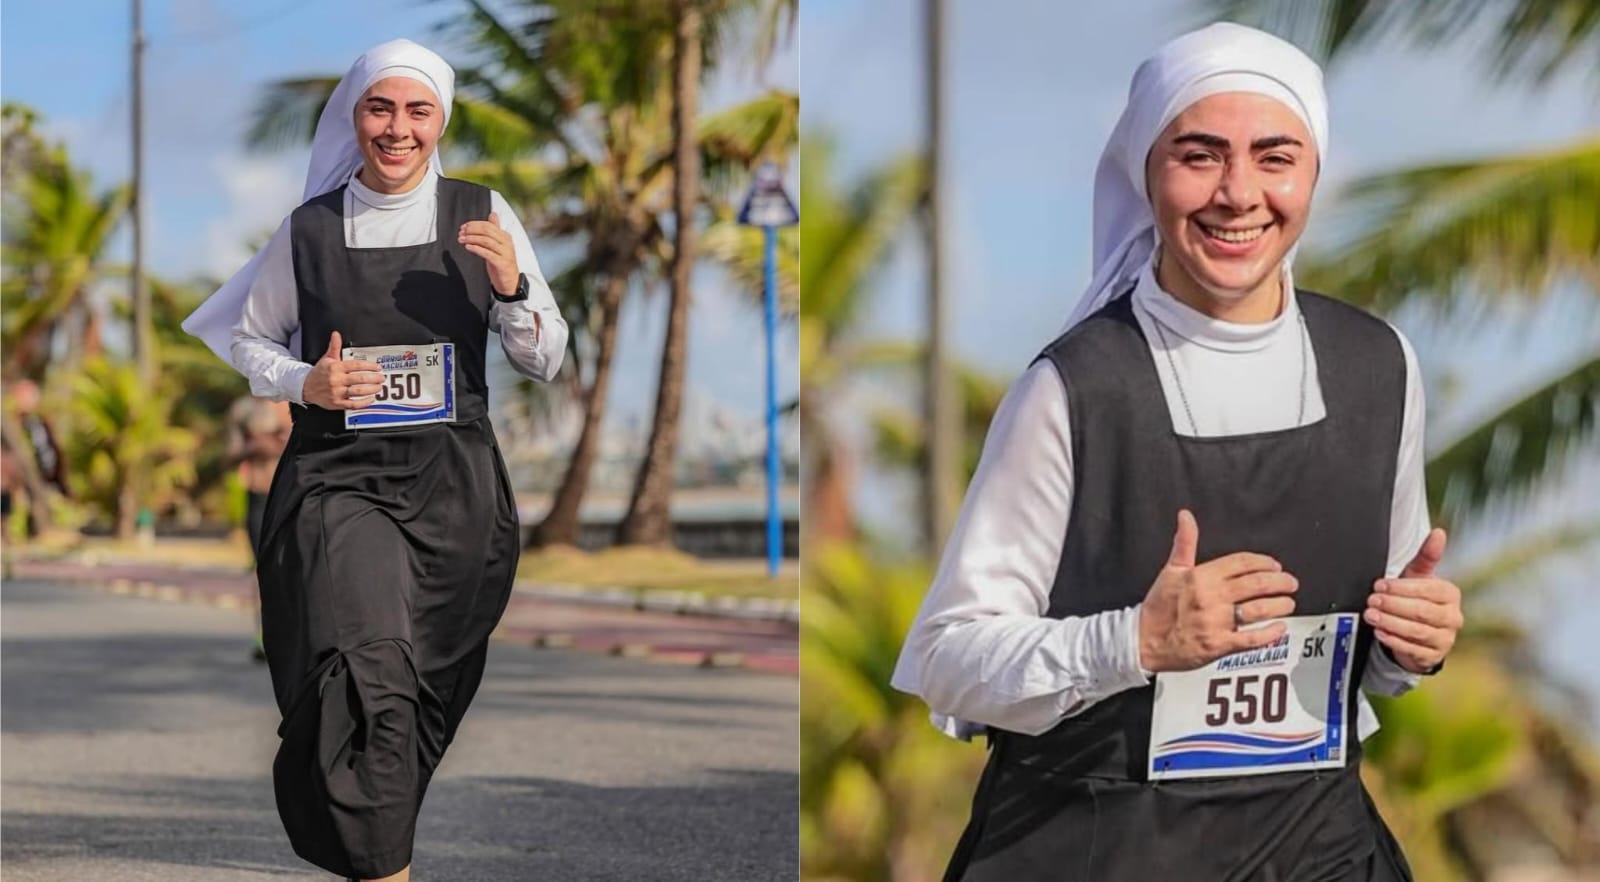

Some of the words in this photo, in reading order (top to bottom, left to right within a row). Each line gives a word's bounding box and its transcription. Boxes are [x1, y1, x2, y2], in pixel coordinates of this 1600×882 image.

[382, 360, 418, 369] MACULADA
[426, 355, 439, 366] 5K
[1303, 637, 1325, 658] 5K
[1217, 648, 1289, 670] IMACULADA
[1205, 673, 1289, 727] 550
